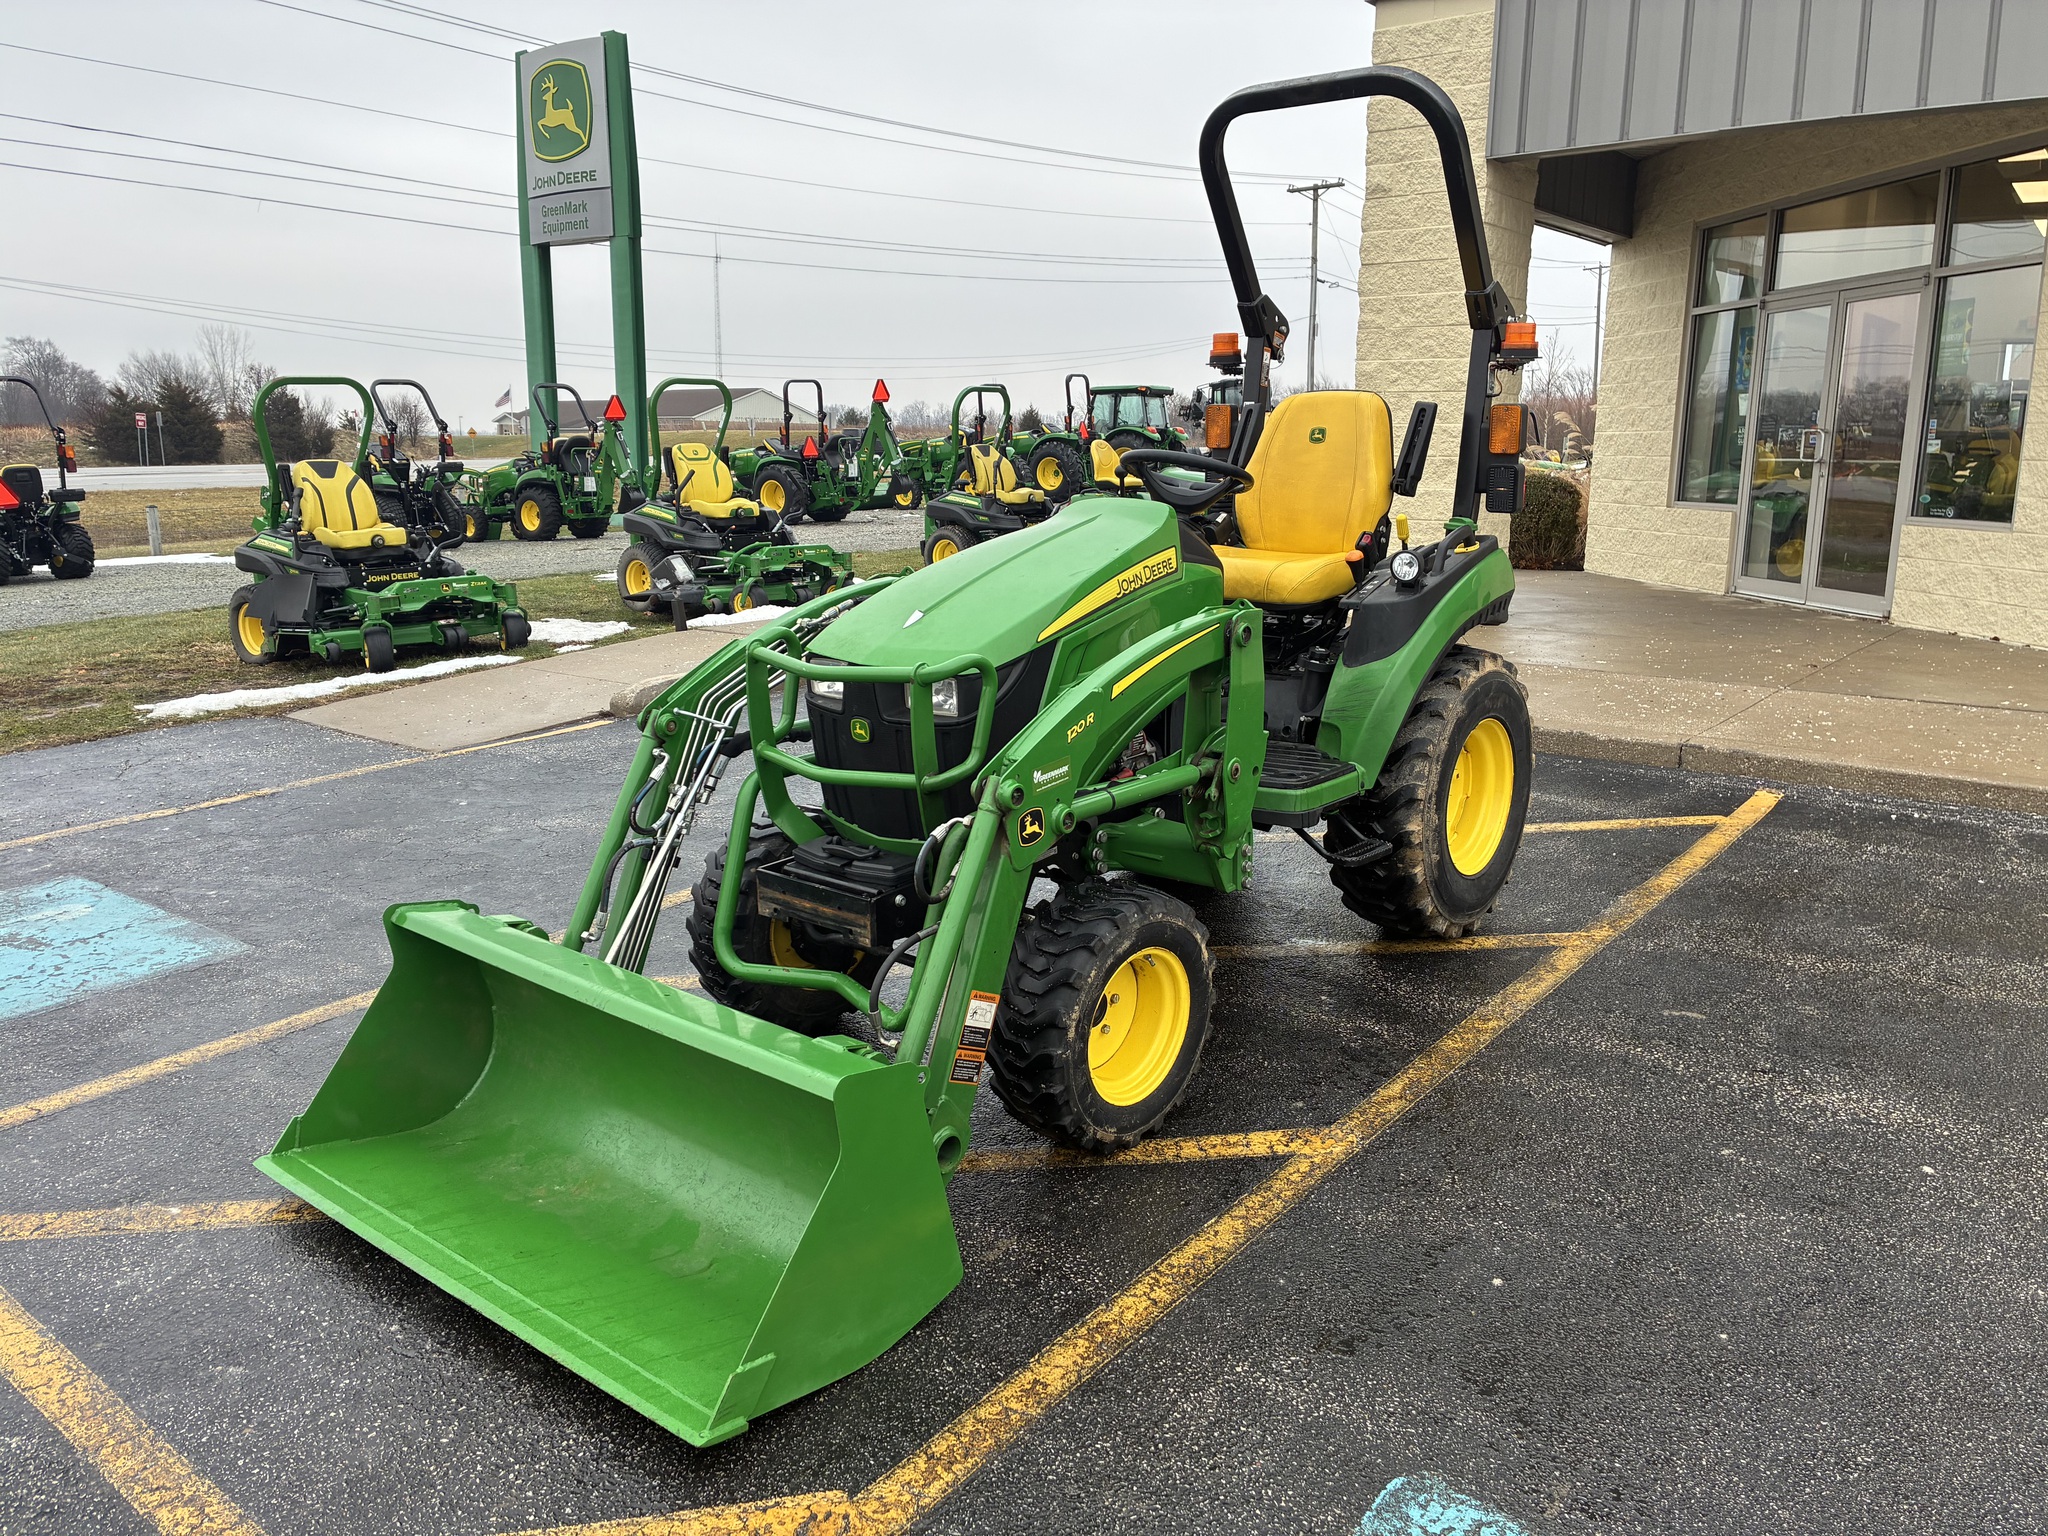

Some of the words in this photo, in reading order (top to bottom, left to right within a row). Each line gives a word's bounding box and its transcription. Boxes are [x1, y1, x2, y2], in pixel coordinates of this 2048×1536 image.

[532, 170, 557, 191] JOHN
[557, 169, 598, 186] DEERE
[541, 199, 588, 218] GreenMark
[542, 216, 589, 235] Equipment
[366, 573, 390, 583] JOHN
[391, 571, 419, 580] DEERE
[1116, 571, 1144, 596] JOHN
[1143, 557, 1174, 580] DEERE
[1066, 719, 1086, 743] 120
[1086, 711, 1095, 727] R
[978, 993, 996, 1002] WARNING
[963, 1052, 982, 1061] WARNING
